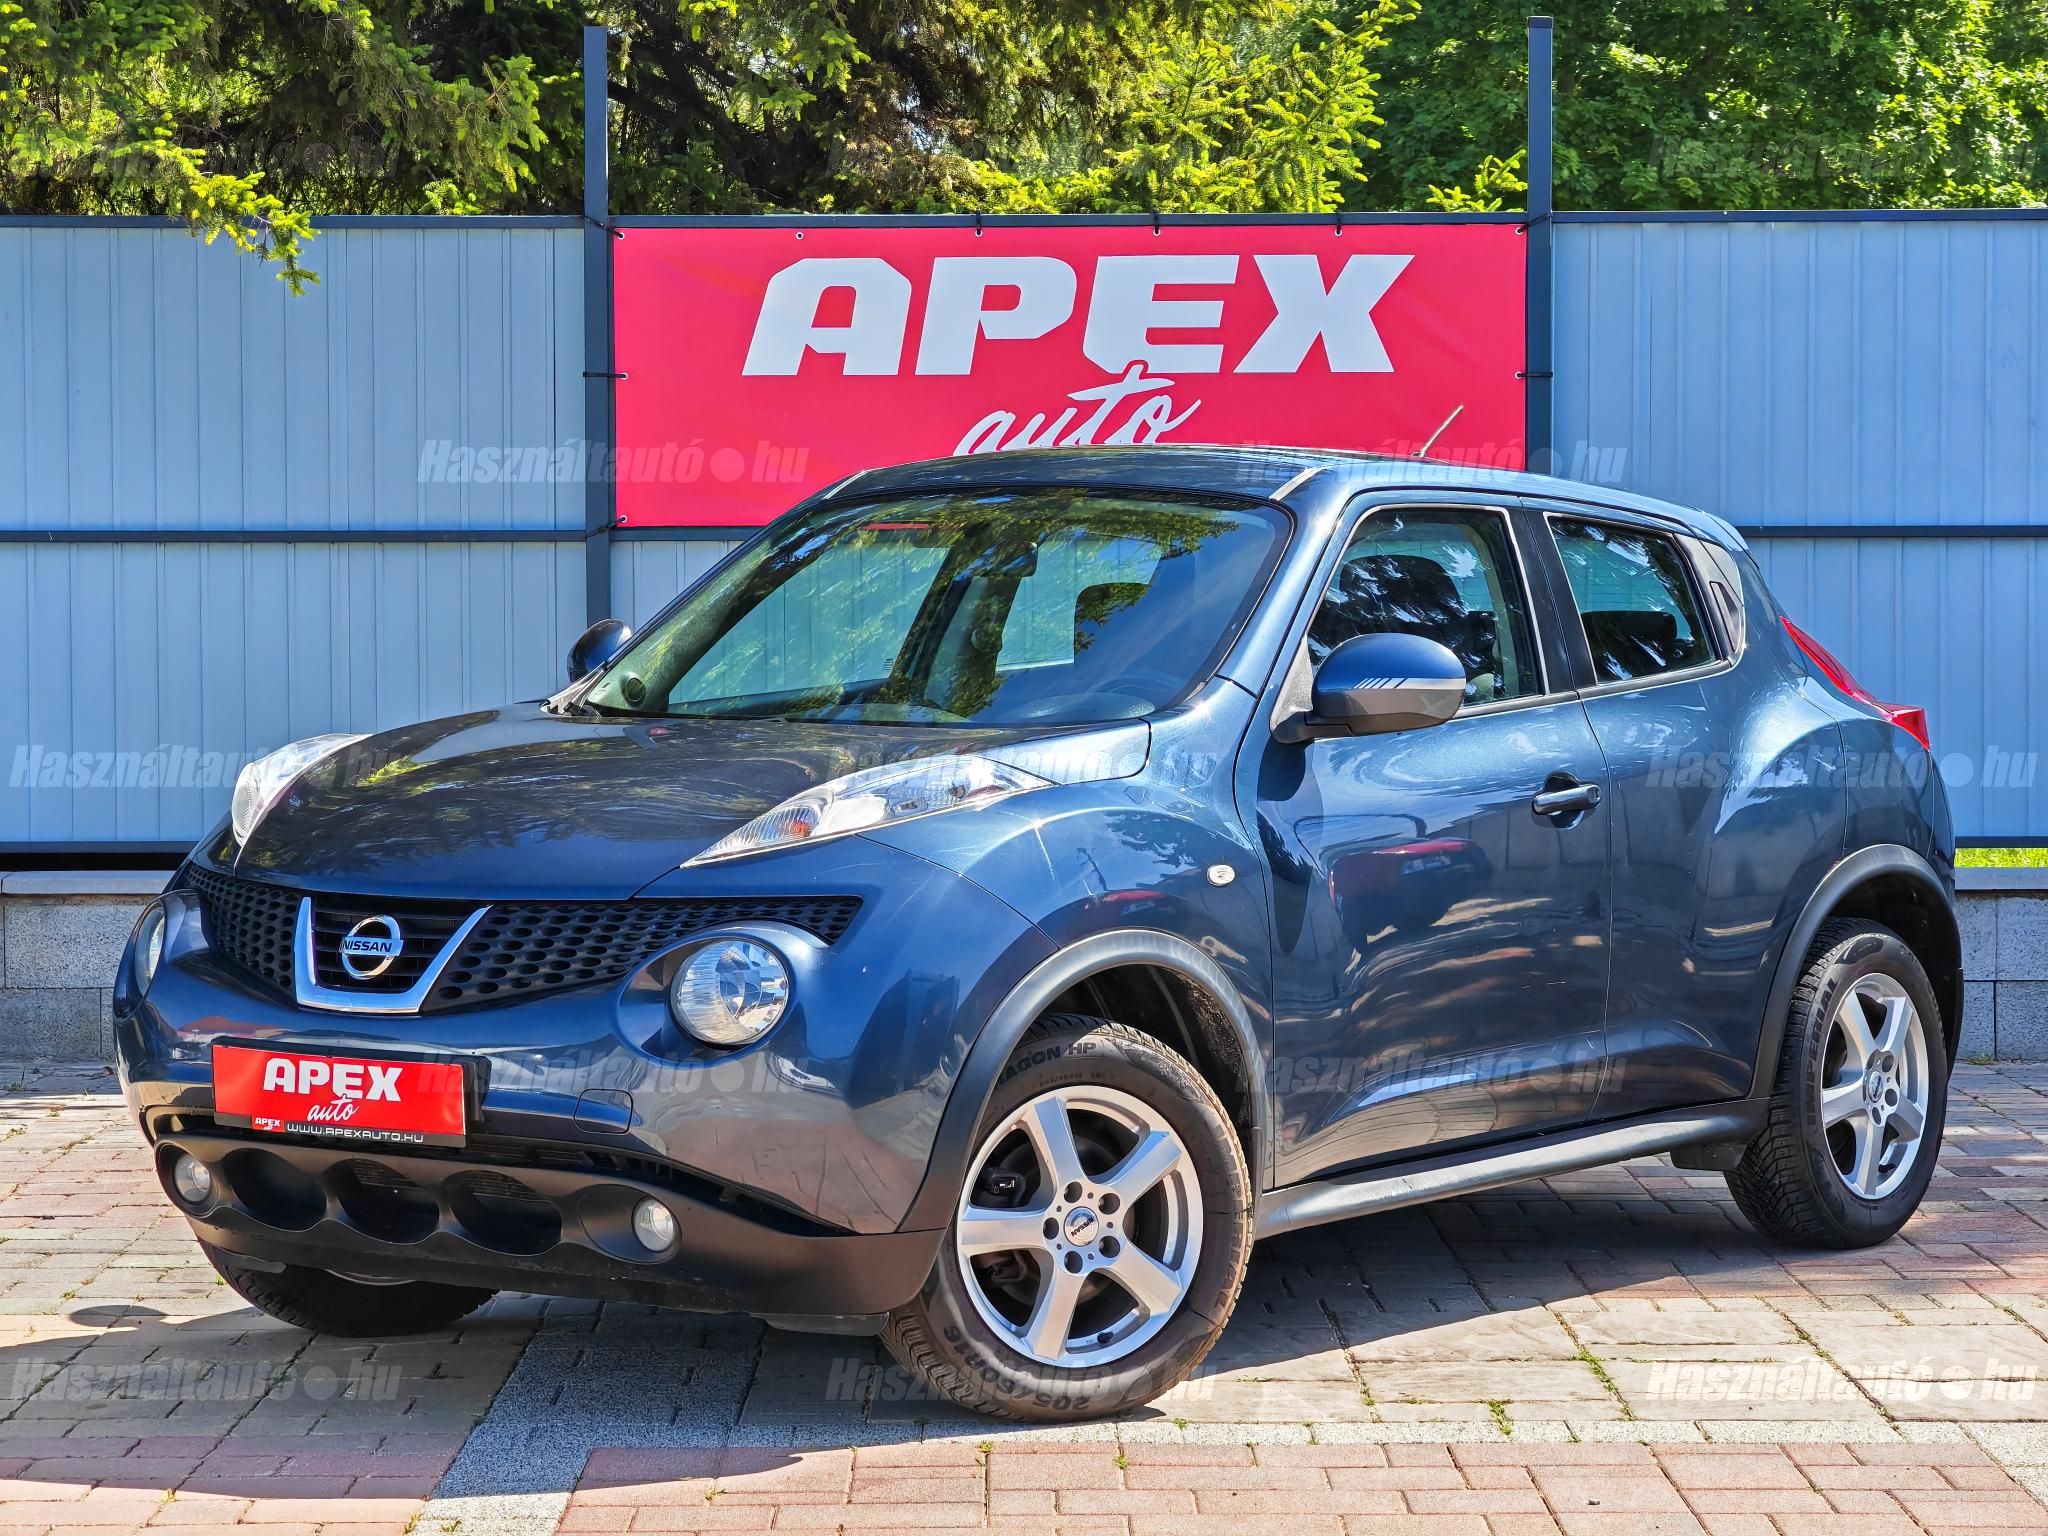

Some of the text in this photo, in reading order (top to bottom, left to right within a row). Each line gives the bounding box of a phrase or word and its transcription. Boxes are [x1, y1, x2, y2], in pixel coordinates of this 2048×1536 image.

[742, 255, 1414, 375] APEX
[953, 364, 1201, 456] auto
[342, 940, 393, 953] NISSAN
[1069, 1042, 1097, 1056] HP
[1807, 977, 1839, 1125] IMPERIAL
[263, 1057, 404, 1102] APEX
[307, 1094, 360, 1122] auto
[255, 1117, 425, 1143] APEX WWW.APEXAUTO.HU
[1071, 1216, 1095, 1238] NISSAN
